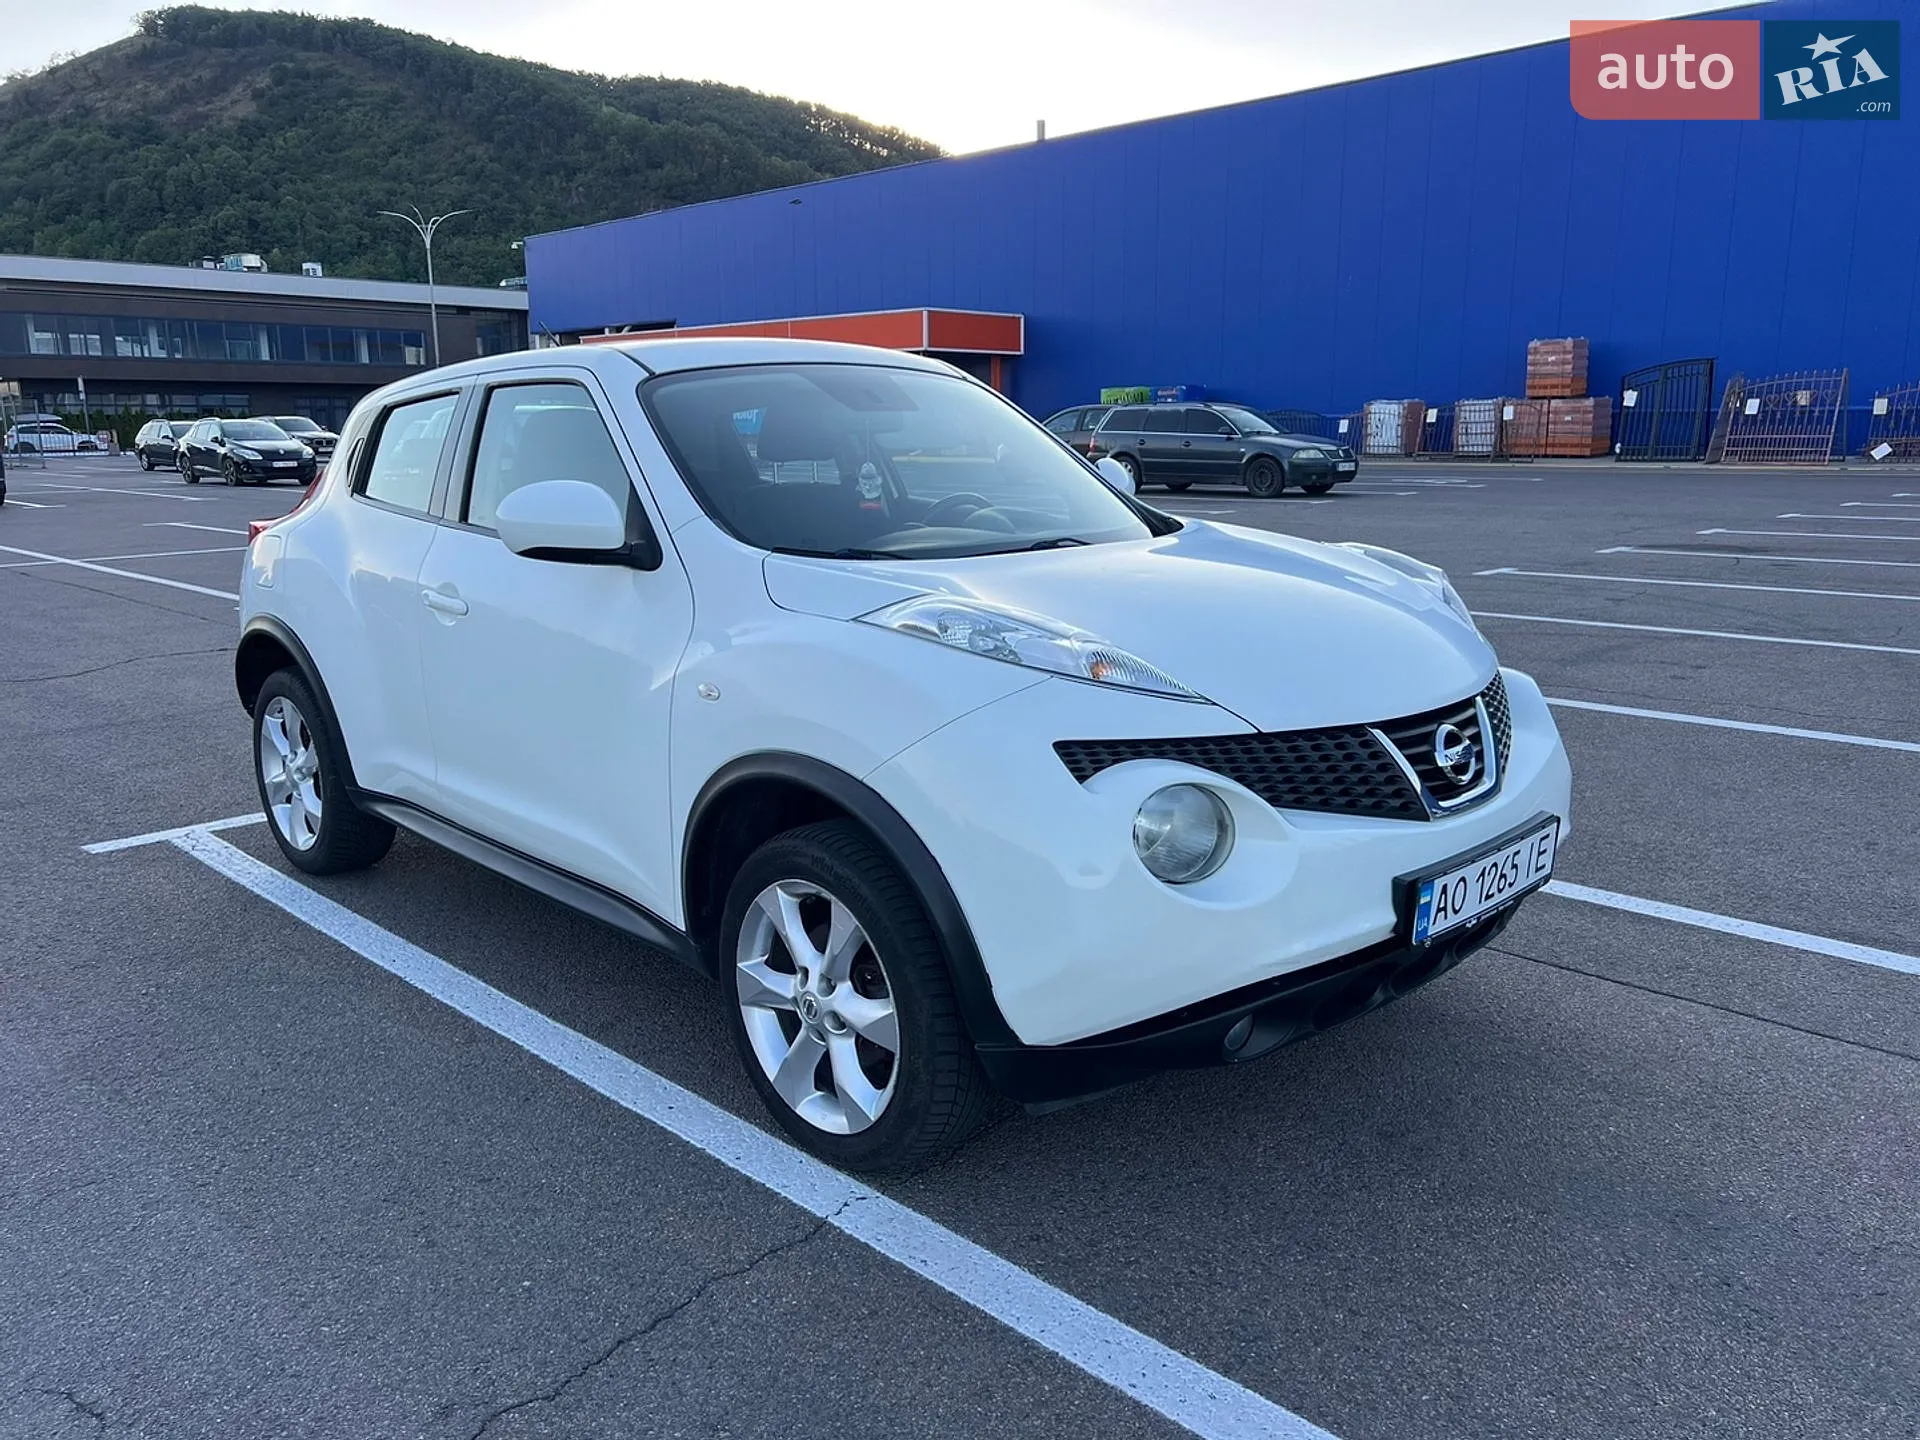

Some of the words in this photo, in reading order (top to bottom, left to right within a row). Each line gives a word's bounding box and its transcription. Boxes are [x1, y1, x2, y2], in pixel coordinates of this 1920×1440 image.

[1432, 876, 1468, 926] AO
[1475, 849, 1522, 905] 1265
[1526, 833, 1551, 880] IE
